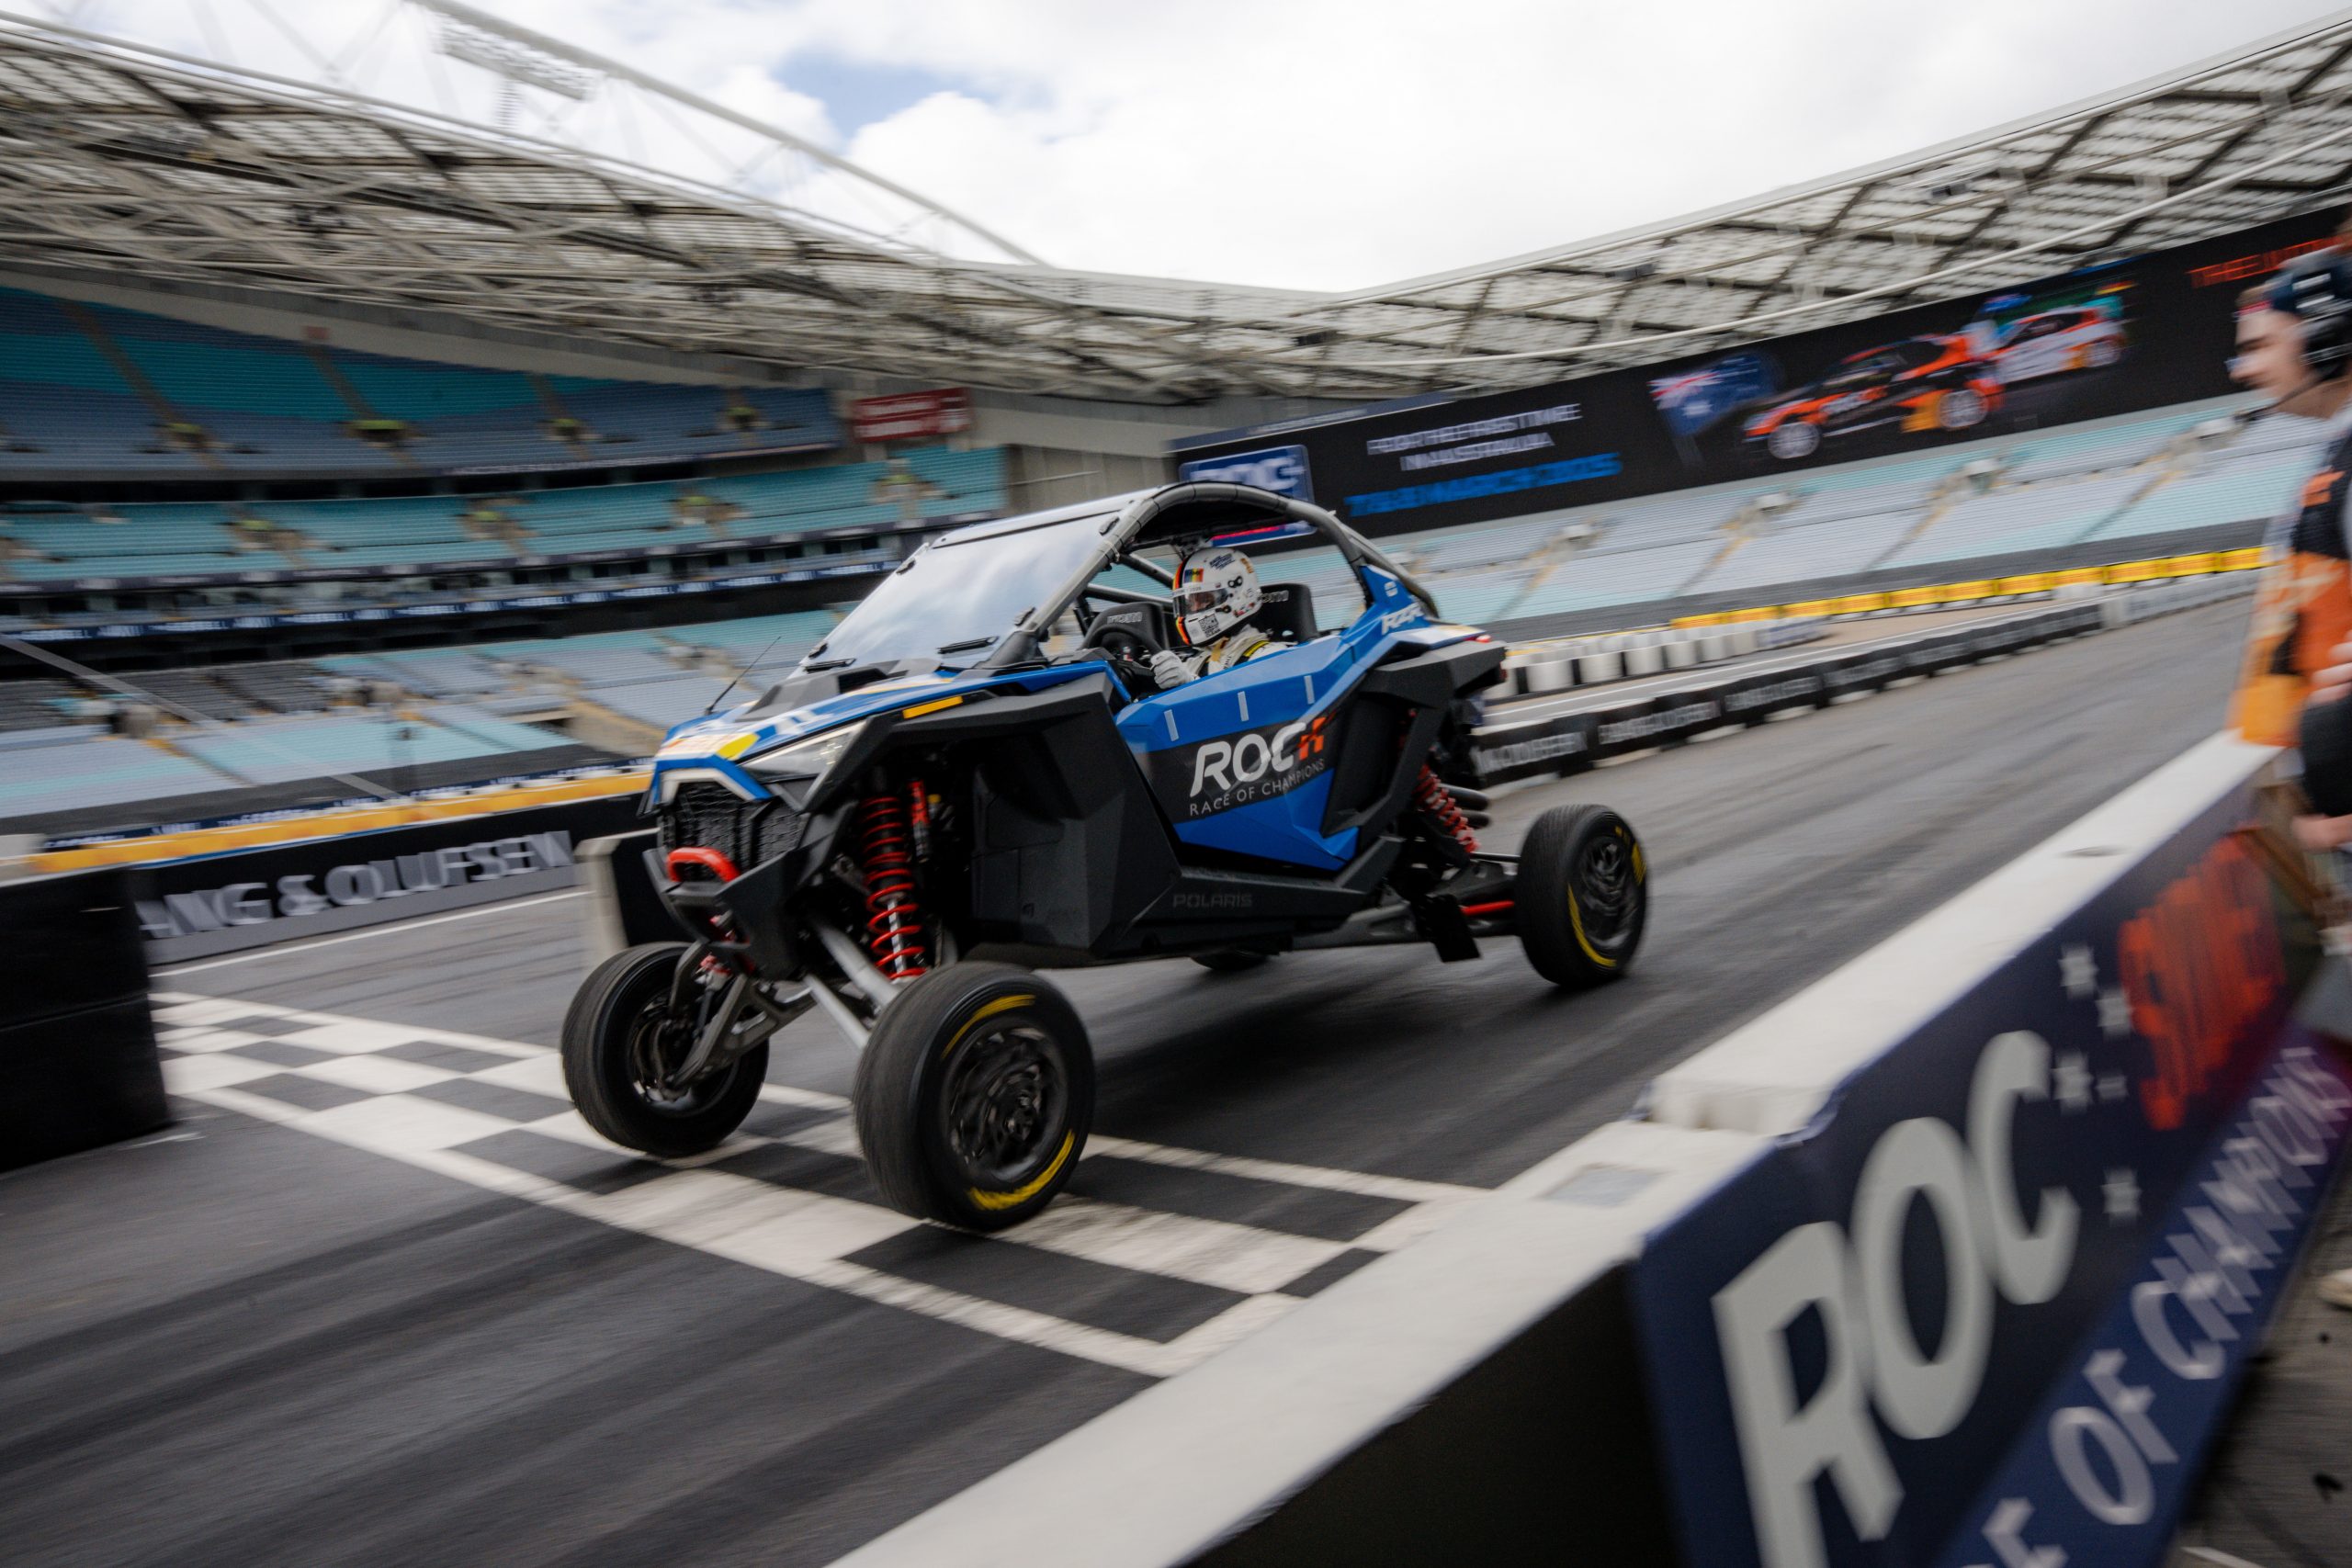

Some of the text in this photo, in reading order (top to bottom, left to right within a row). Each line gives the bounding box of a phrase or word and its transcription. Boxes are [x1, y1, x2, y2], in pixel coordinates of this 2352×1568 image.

[1190, 722, 1306, 798] ROC
[1190, 758, 1325, 817] RACE OF CHAMPIONS
[1172, 894, 1252, 908] POLARIS
[1710, 1030, 2081, 1568] ROC
[2049, 1348, 2180, 1526] OF
